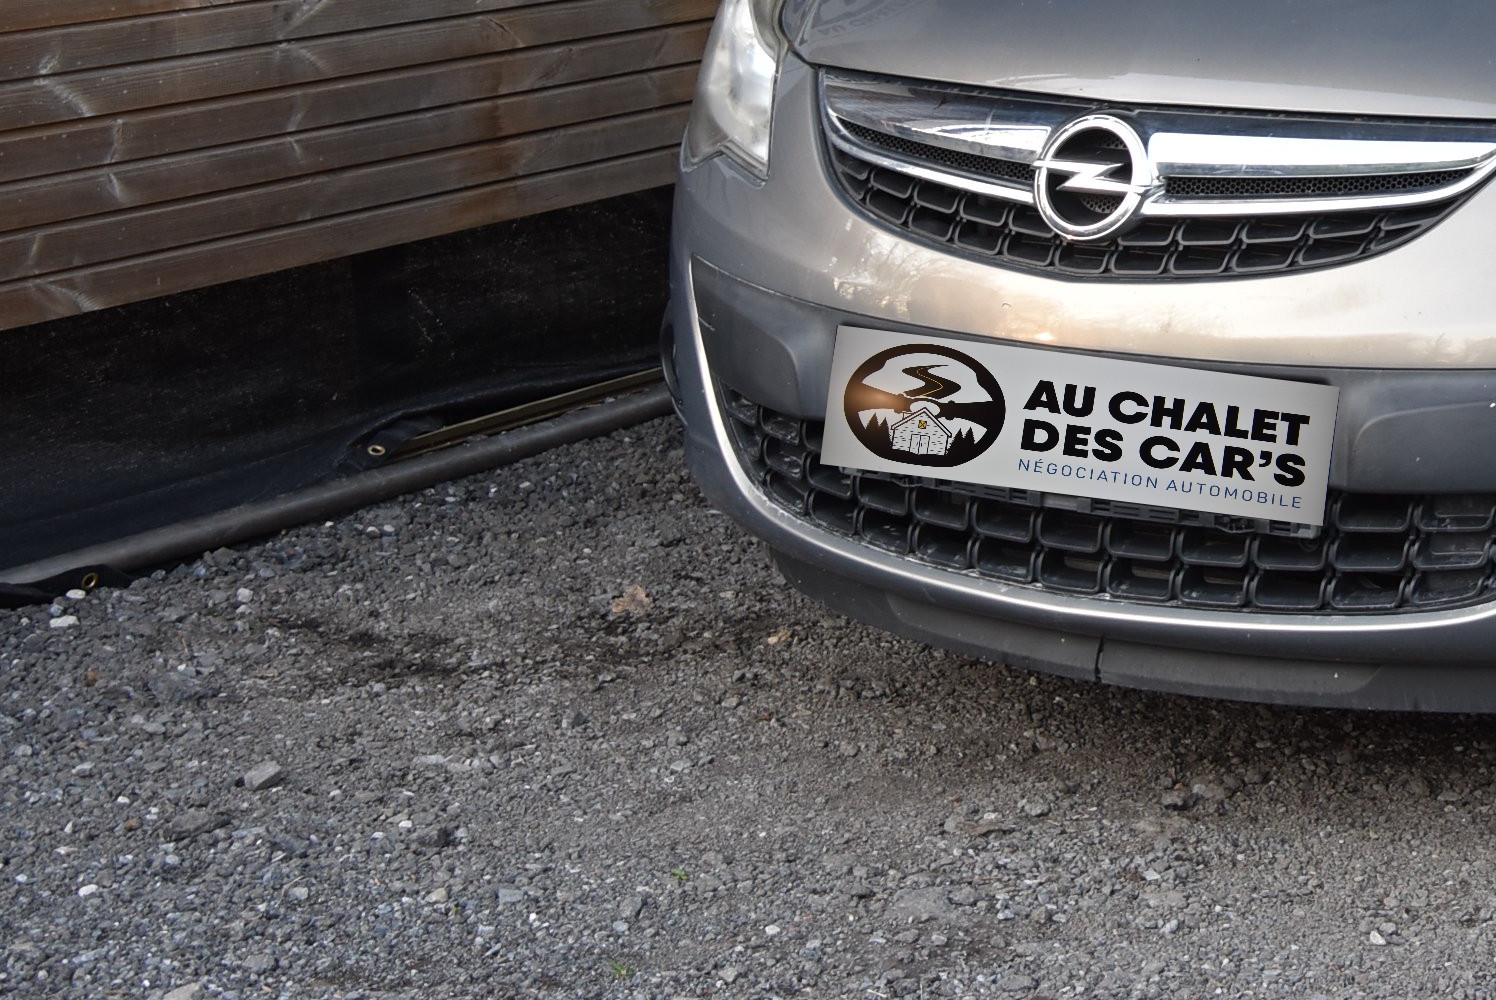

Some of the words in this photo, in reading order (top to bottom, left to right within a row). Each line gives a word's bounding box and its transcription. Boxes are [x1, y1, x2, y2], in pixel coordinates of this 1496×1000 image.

[1023, 379, 1096, 417] AU
[1108, 391, 1310, 446] CHALET
[1018, 458, 1159, 489] NÉGOCIATION
[1166, 479, 1303, 509] AUTOMOBILE
[1020, 419, 1123, 462] DES
[1139, 435, 1306, 487] CAR'S
